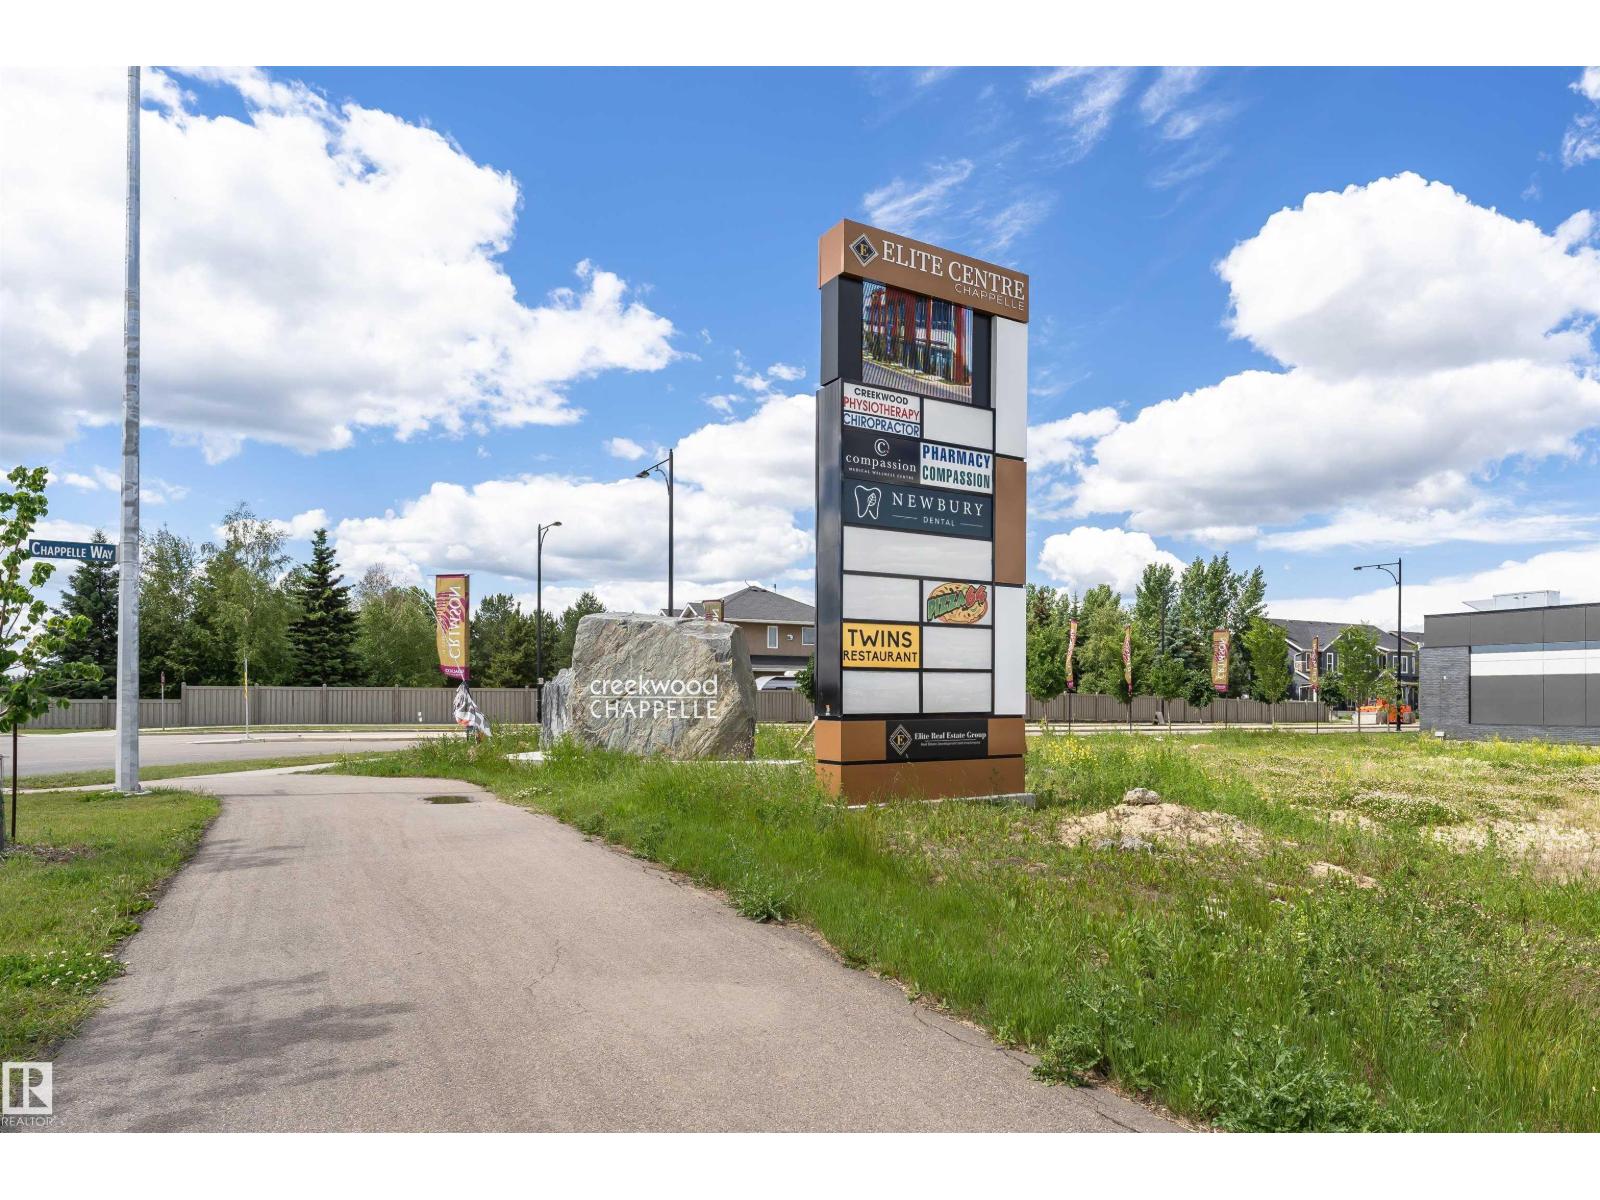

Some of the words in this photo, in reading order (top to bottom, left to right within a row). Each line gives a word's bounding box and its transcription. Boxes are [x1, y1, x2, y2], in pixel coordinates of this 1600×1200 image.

[881, 239, 943, 277] ELITE
[948, 260, 1025, 300] CENTRE
[954, 283, 1024, 311] CHAPPELLE
[854, 387, 909, 406] CREEKWOOD
[843, 396, 920, 421] PHYSIOTHERAPY
[843, 413, 920, 437] CHIROPRACTOR
[845, 454, 917, 472] compassion
[922, 444, 991, 469] PHARMACY
[922, 465, 990, 489] COMPASSION
[891, 492, 984, 516] NEWBURY
[923, 516, 955, 526] DENTAL
[847, 629, 913, 648] TWINS
[843, 650, 918, 662] RESTAURANT
[590, 674, 718, 696] creekwood
[590, 699, 718, 720] CHAPPELLE
[914, 732, 930, 740] Elite
[946, 731, 965, 739] Estate
[966, 731, 987, 740] Group
